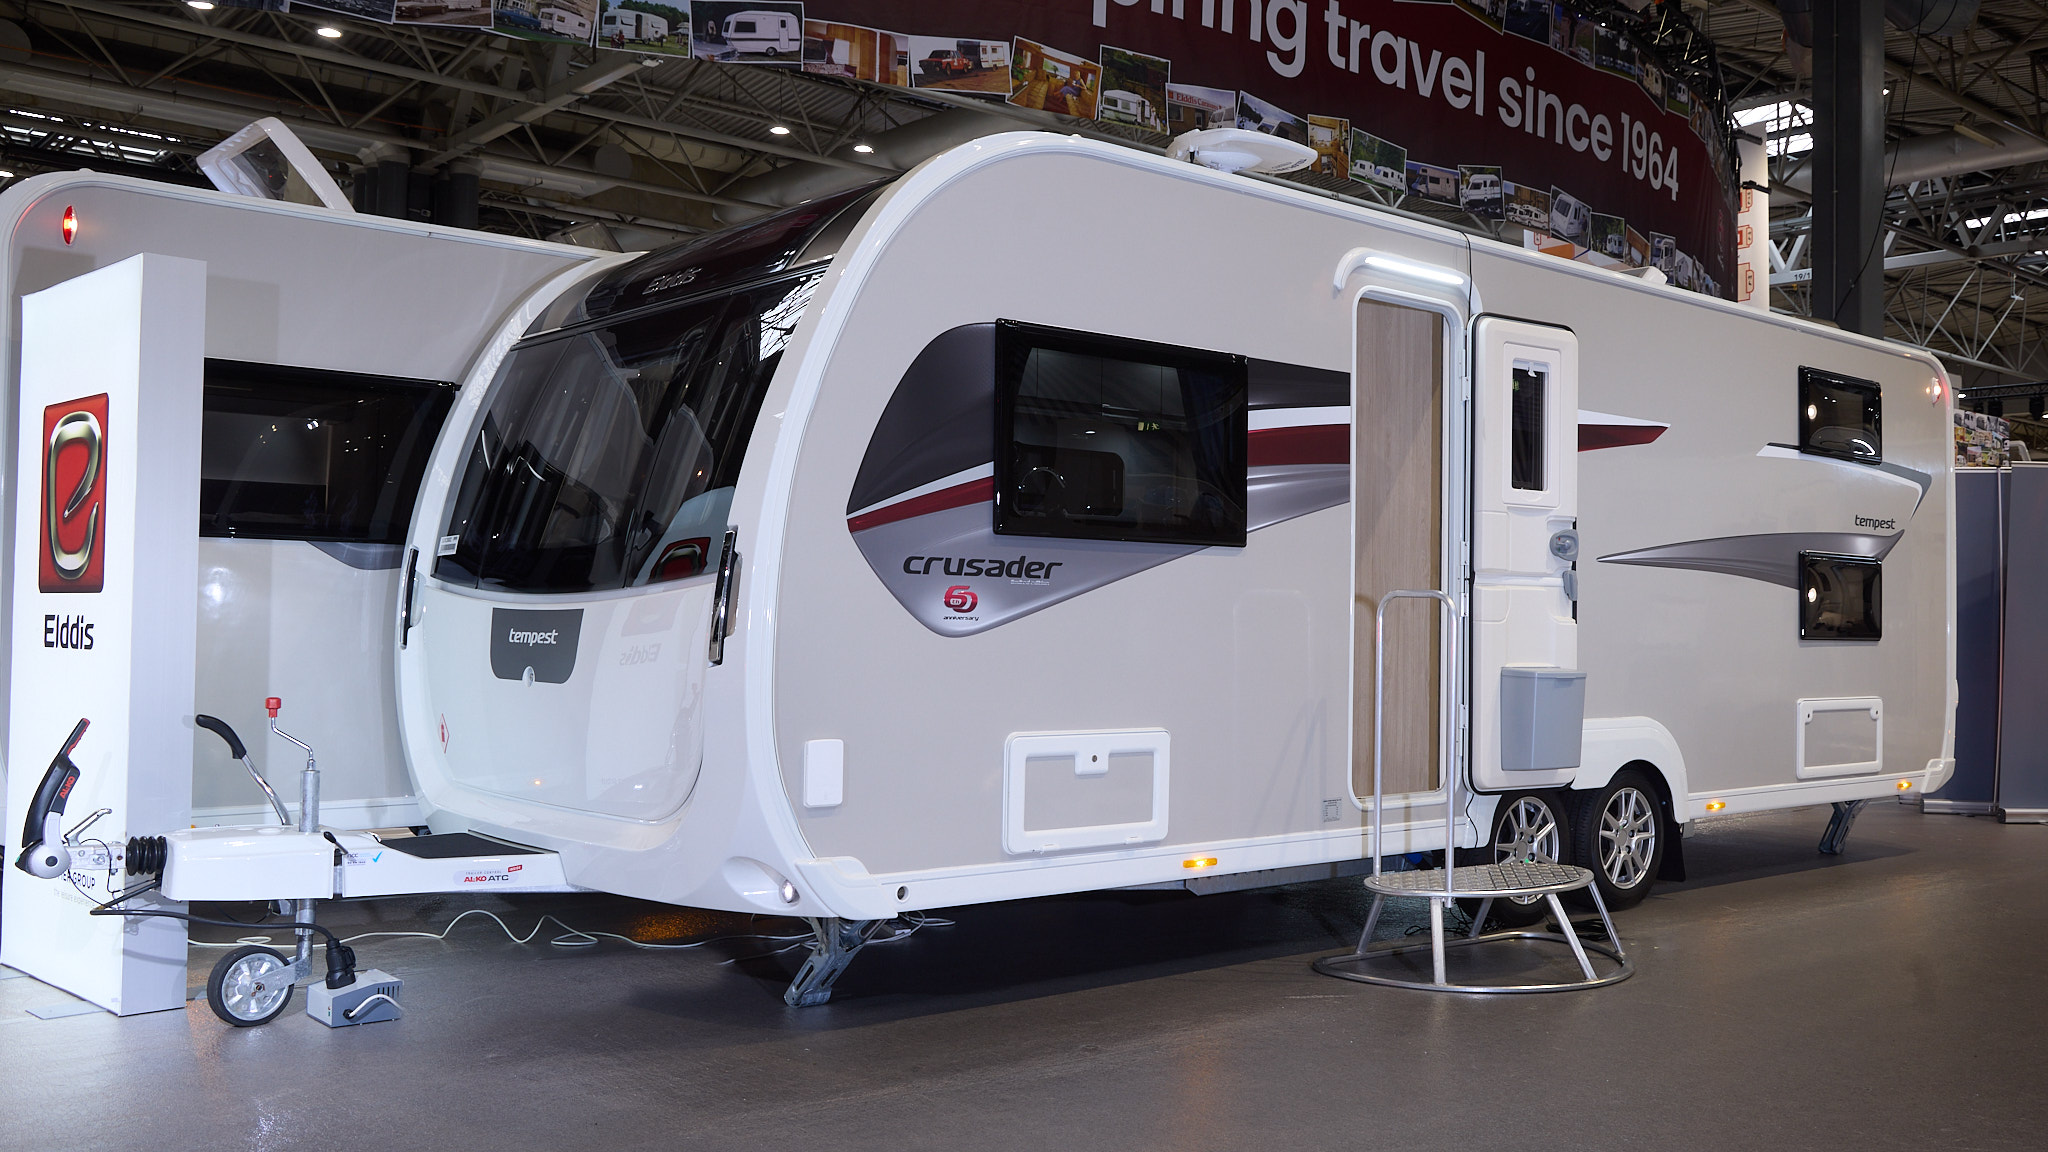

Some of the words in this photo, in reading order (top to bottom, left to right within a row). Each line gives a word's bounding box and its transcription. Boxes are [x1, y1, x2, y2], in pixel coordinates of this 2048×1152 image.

[1324, 0, 1485, 116] travel
[1498, 66, 1612, 162] since
[1621, 112, 1679, 201] 1964
[1855, 514, 1896, 530] tempest
[903, 556, 1063, 579] crusader
[44, 614, 95, 650] Elddis
[508, 628, 559, 647] tempest
[73, 872, 95, 890] GROUP
